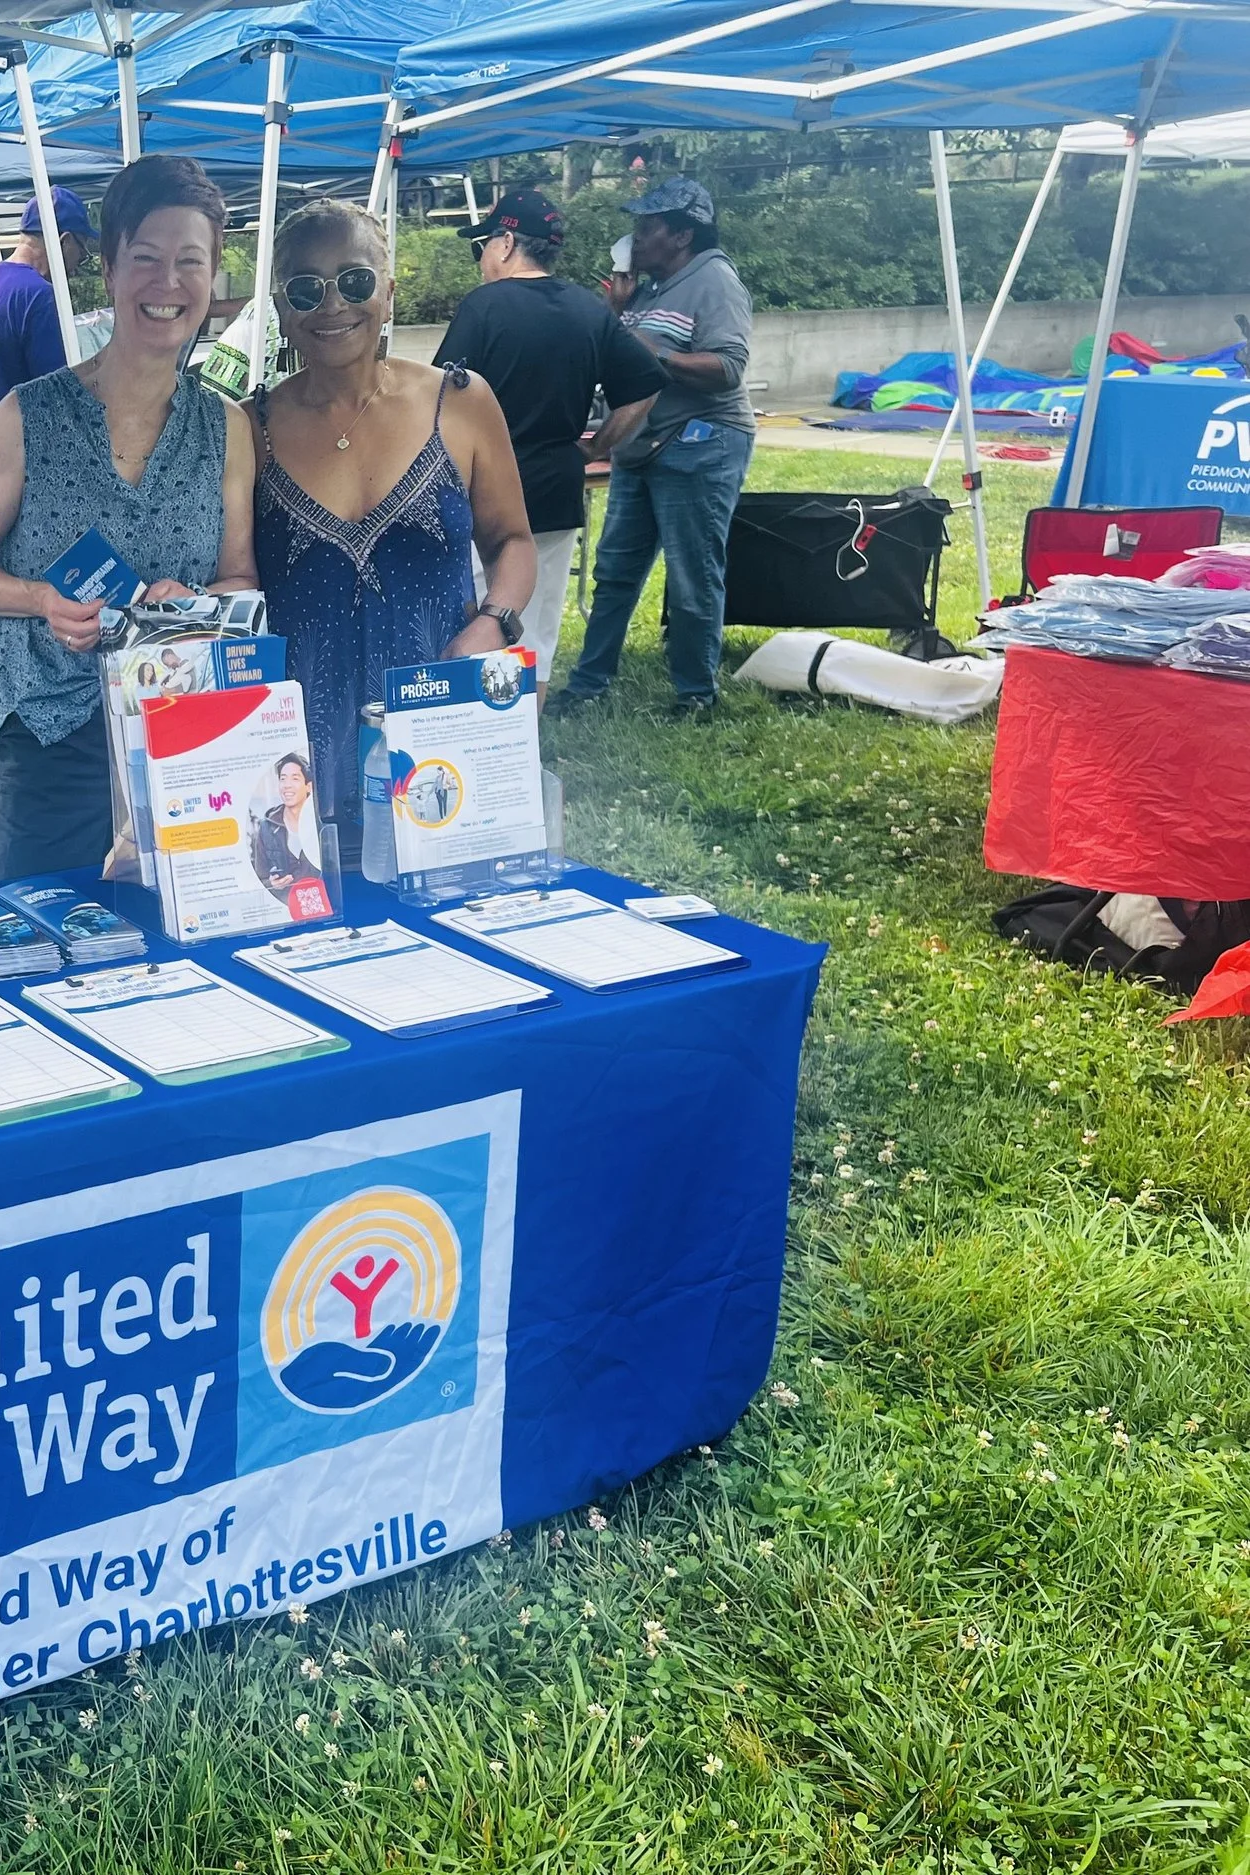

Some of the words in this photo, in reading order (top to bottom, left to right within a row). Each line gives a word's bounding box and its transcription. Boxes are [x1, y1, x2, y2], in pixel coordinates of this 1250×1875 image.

[499, 215, 519, 228] 1913
[225, 644, 256, 659] DRIVING
[227, 657, 246, 671] LIVES
[228, 668, 263, 684] FORWARD
[400, 680, 450, 700] PROSPER
[279, 696, 294, 709] LYFT
[261, 710, 296, 724] PROGRAM
[183, 797, 202, 807] UNITED
[208, 791, 232, 812] lyft
[184, 805, 195, 814] WAY
[4, 1371, 218, 1497] Way
[48, 1542, 168, 1608] Way
[182, 1505, 236, 1566] of
[77, 1512, 448, 1665] Charlottesville
